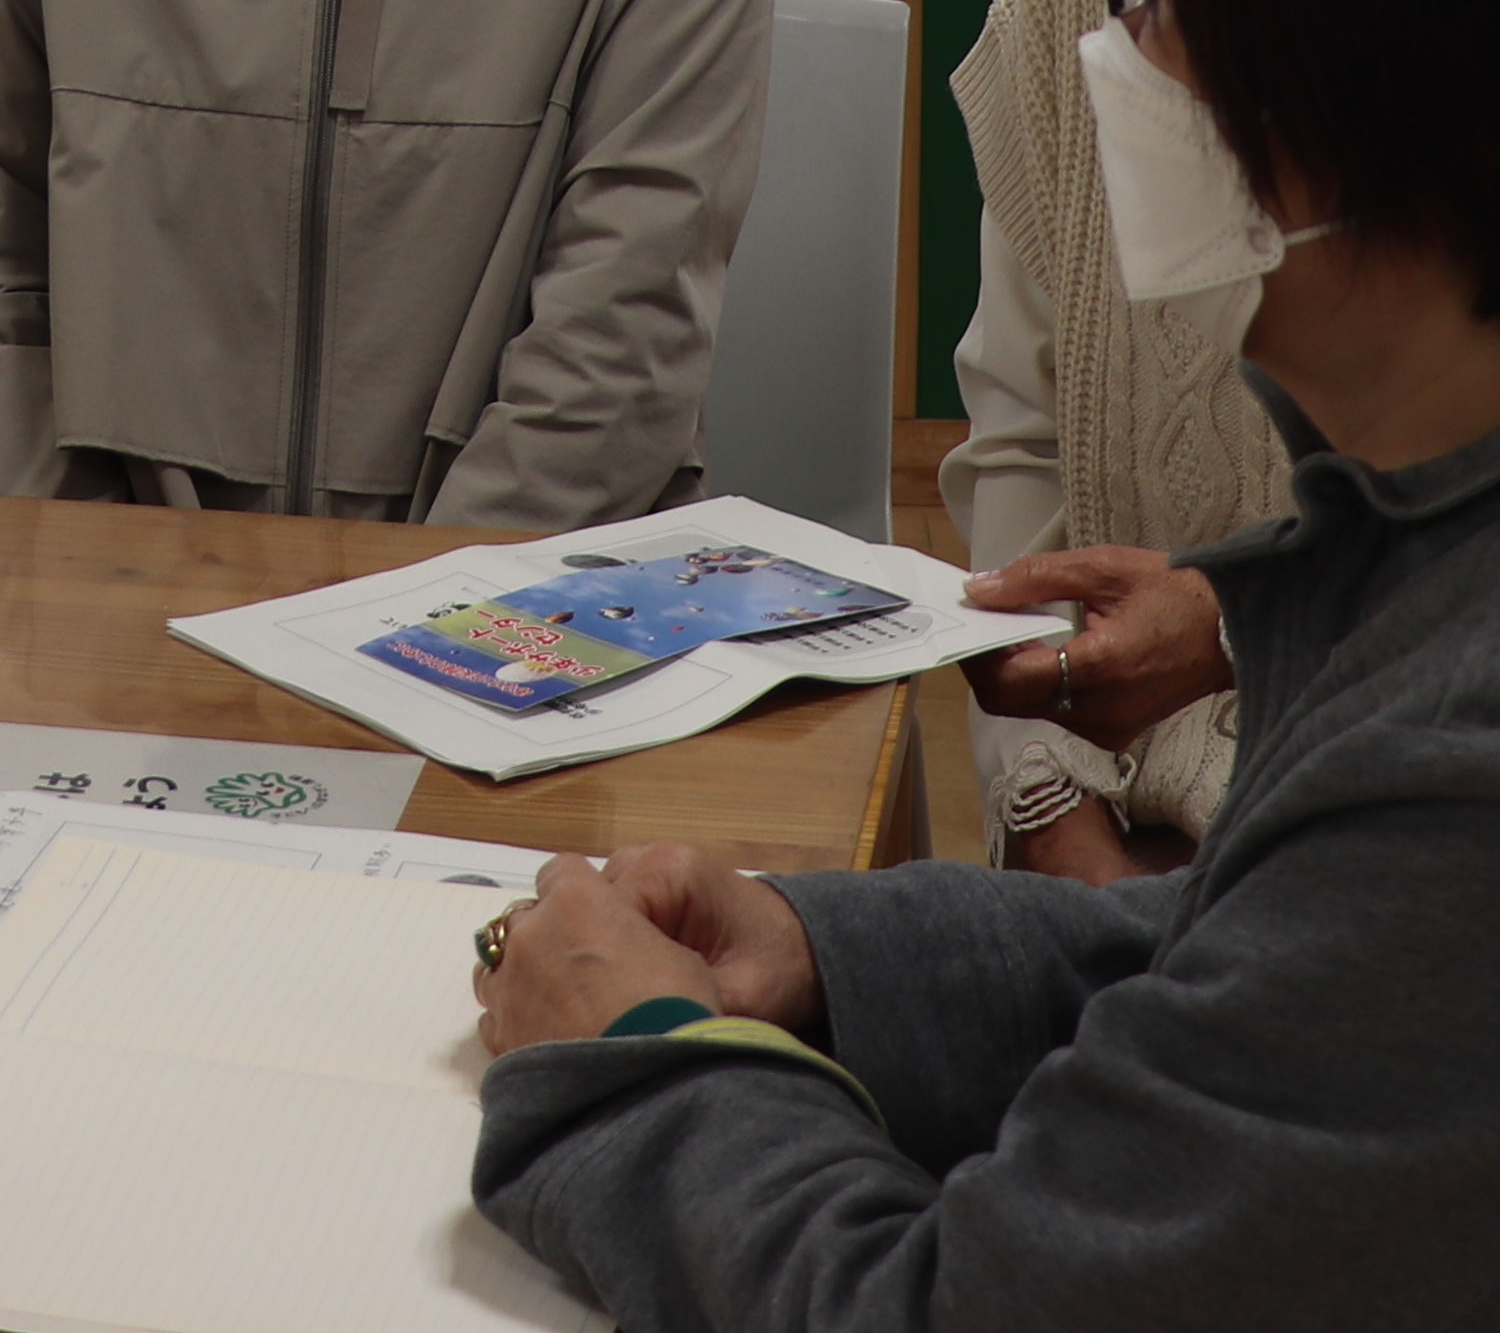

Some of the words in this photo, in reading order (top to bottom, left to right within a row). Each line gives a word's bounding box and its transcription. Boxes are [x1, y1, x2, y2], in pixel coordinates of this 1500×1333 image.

[474, 608, 565, 646] センター
[467, 626, 606, 678] 少年サポート
